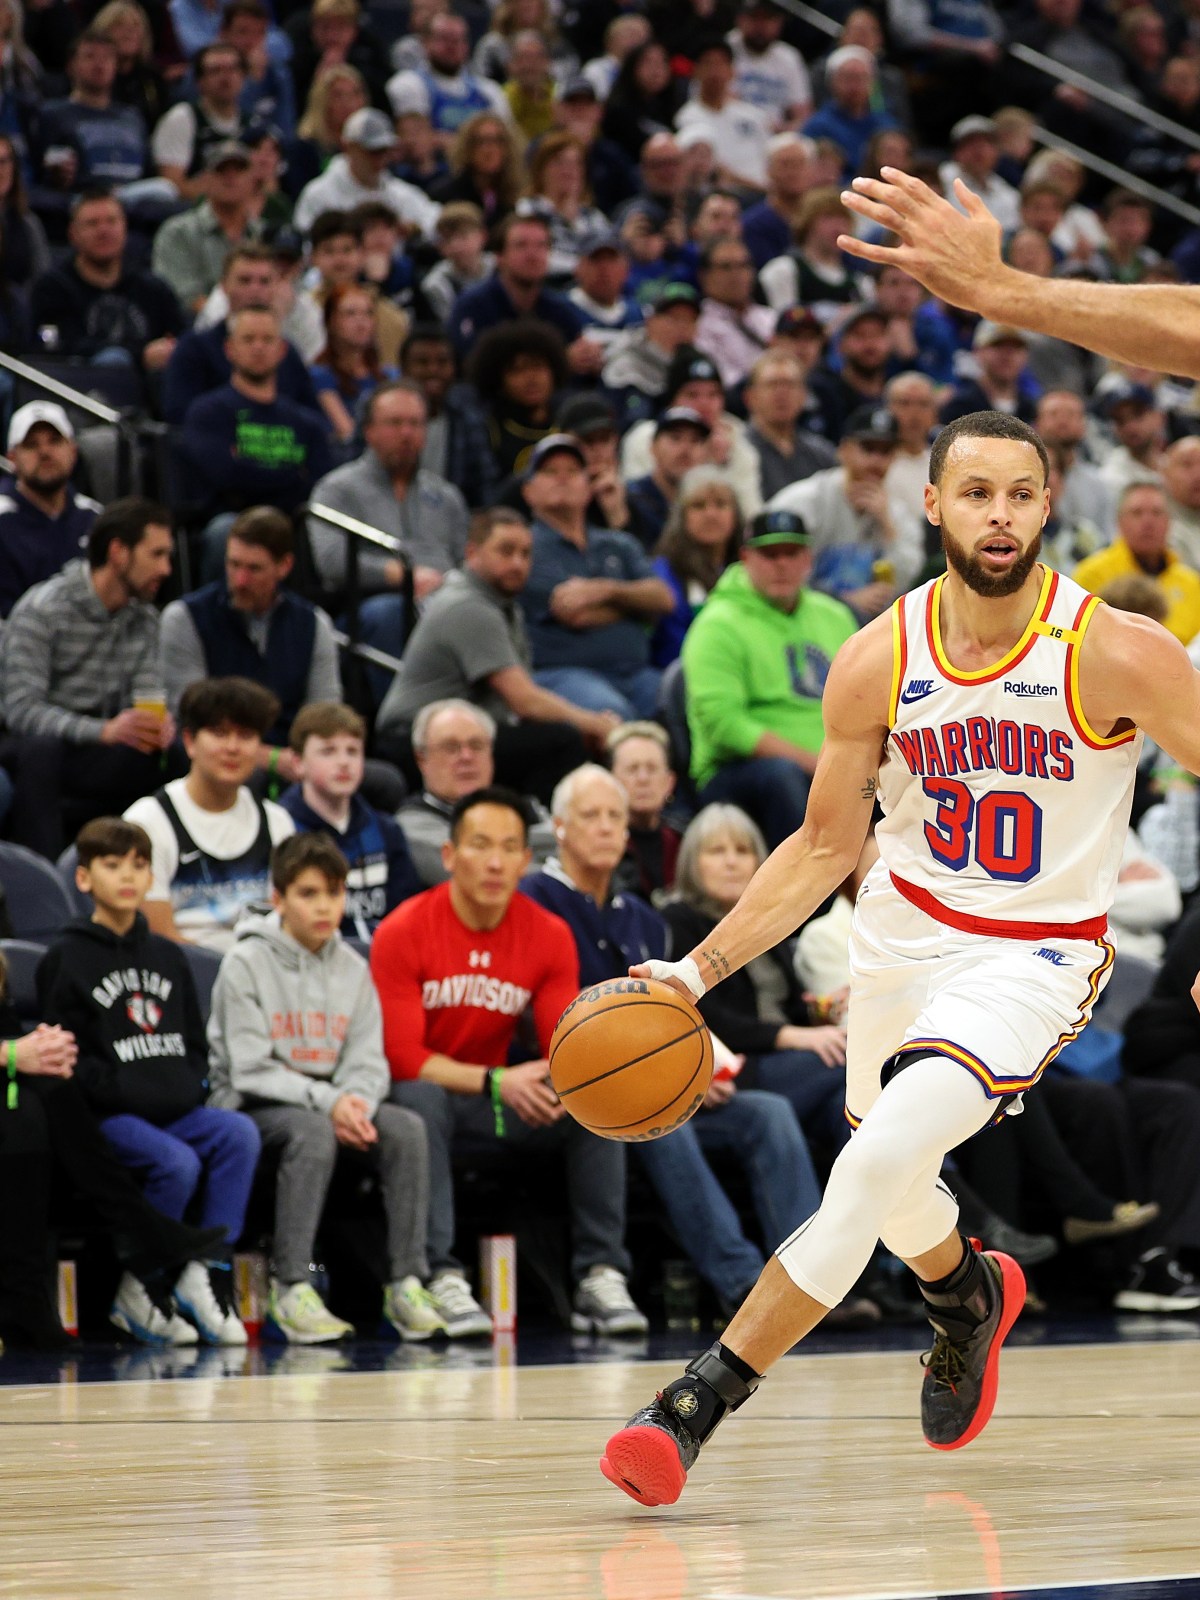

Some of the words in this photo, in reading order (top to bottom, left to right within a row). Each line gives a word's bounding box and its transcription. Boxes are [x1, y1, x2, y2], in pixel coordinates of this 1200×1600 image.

[1050, 627, 1063, 639] 16
[906, 680, 934, 694] NIKE
[1003, 681, 1058, 697] Rakuten
[891, 716, 1075, 782] WARRORS
[922, 776, 1043, 883] 30
[1037, 947, 1065, 963] NIKE
[92, 967, 173, 1009] DAVIDSON
[112, 1033, 186, 1063] WILDCATS
